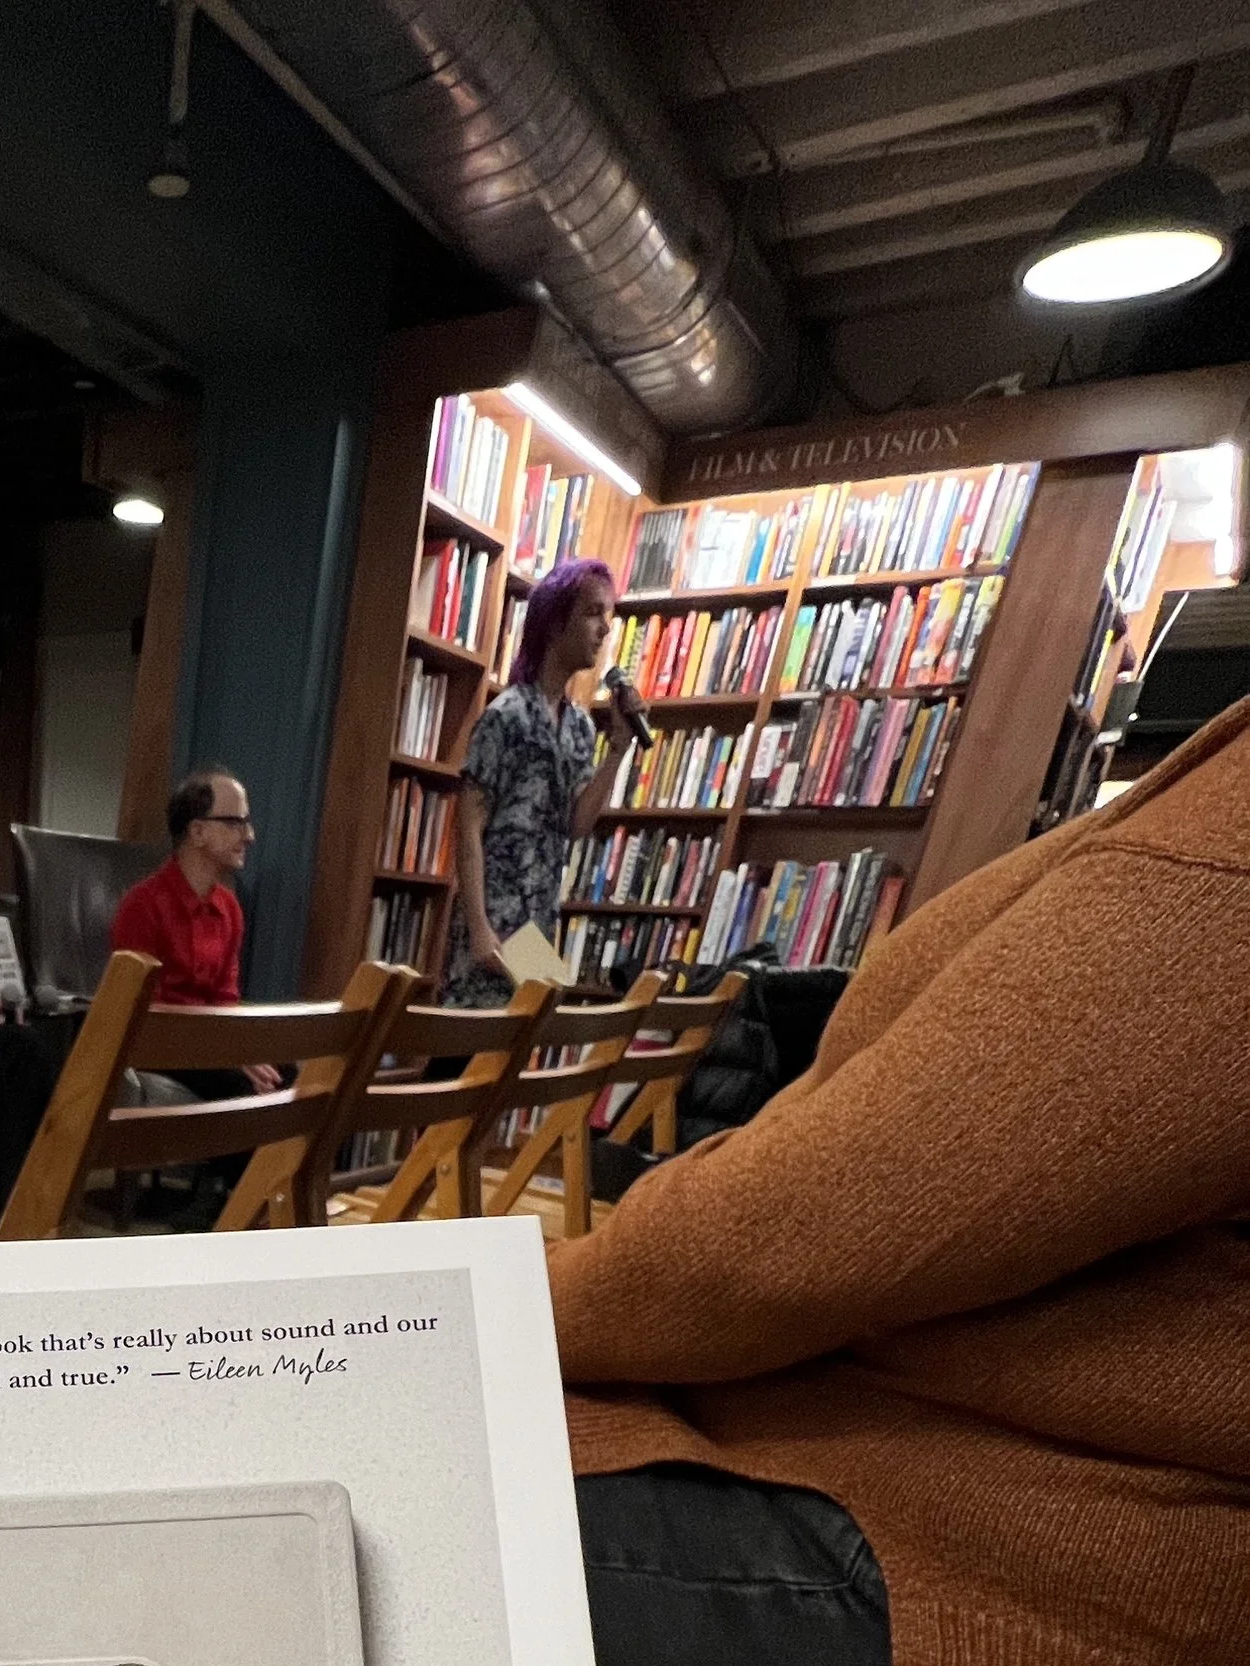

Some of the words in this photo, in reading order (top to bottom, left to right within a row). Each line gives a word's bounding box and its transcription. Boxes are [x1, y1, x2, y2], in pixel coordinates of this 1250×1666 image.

[689, 450, 755, 483] FILM
[759, 447, 781, 474] &
[790, 423, 966, 471] TELEVISION
[40, 1332, 104, 1351] that’s
[113, 1328, 177, 1352] really
[186, 1326, 253, 1345] about
[262, 1319, 335, 1341] sound
[344, 1316, 388, 1335] and
[397, 1318, 438, 1332] our
[10, 1369, 52, 1388] and
[188, 1359, 264, 1380] Eileen
[273, 1348, 347, 1385] Myles
